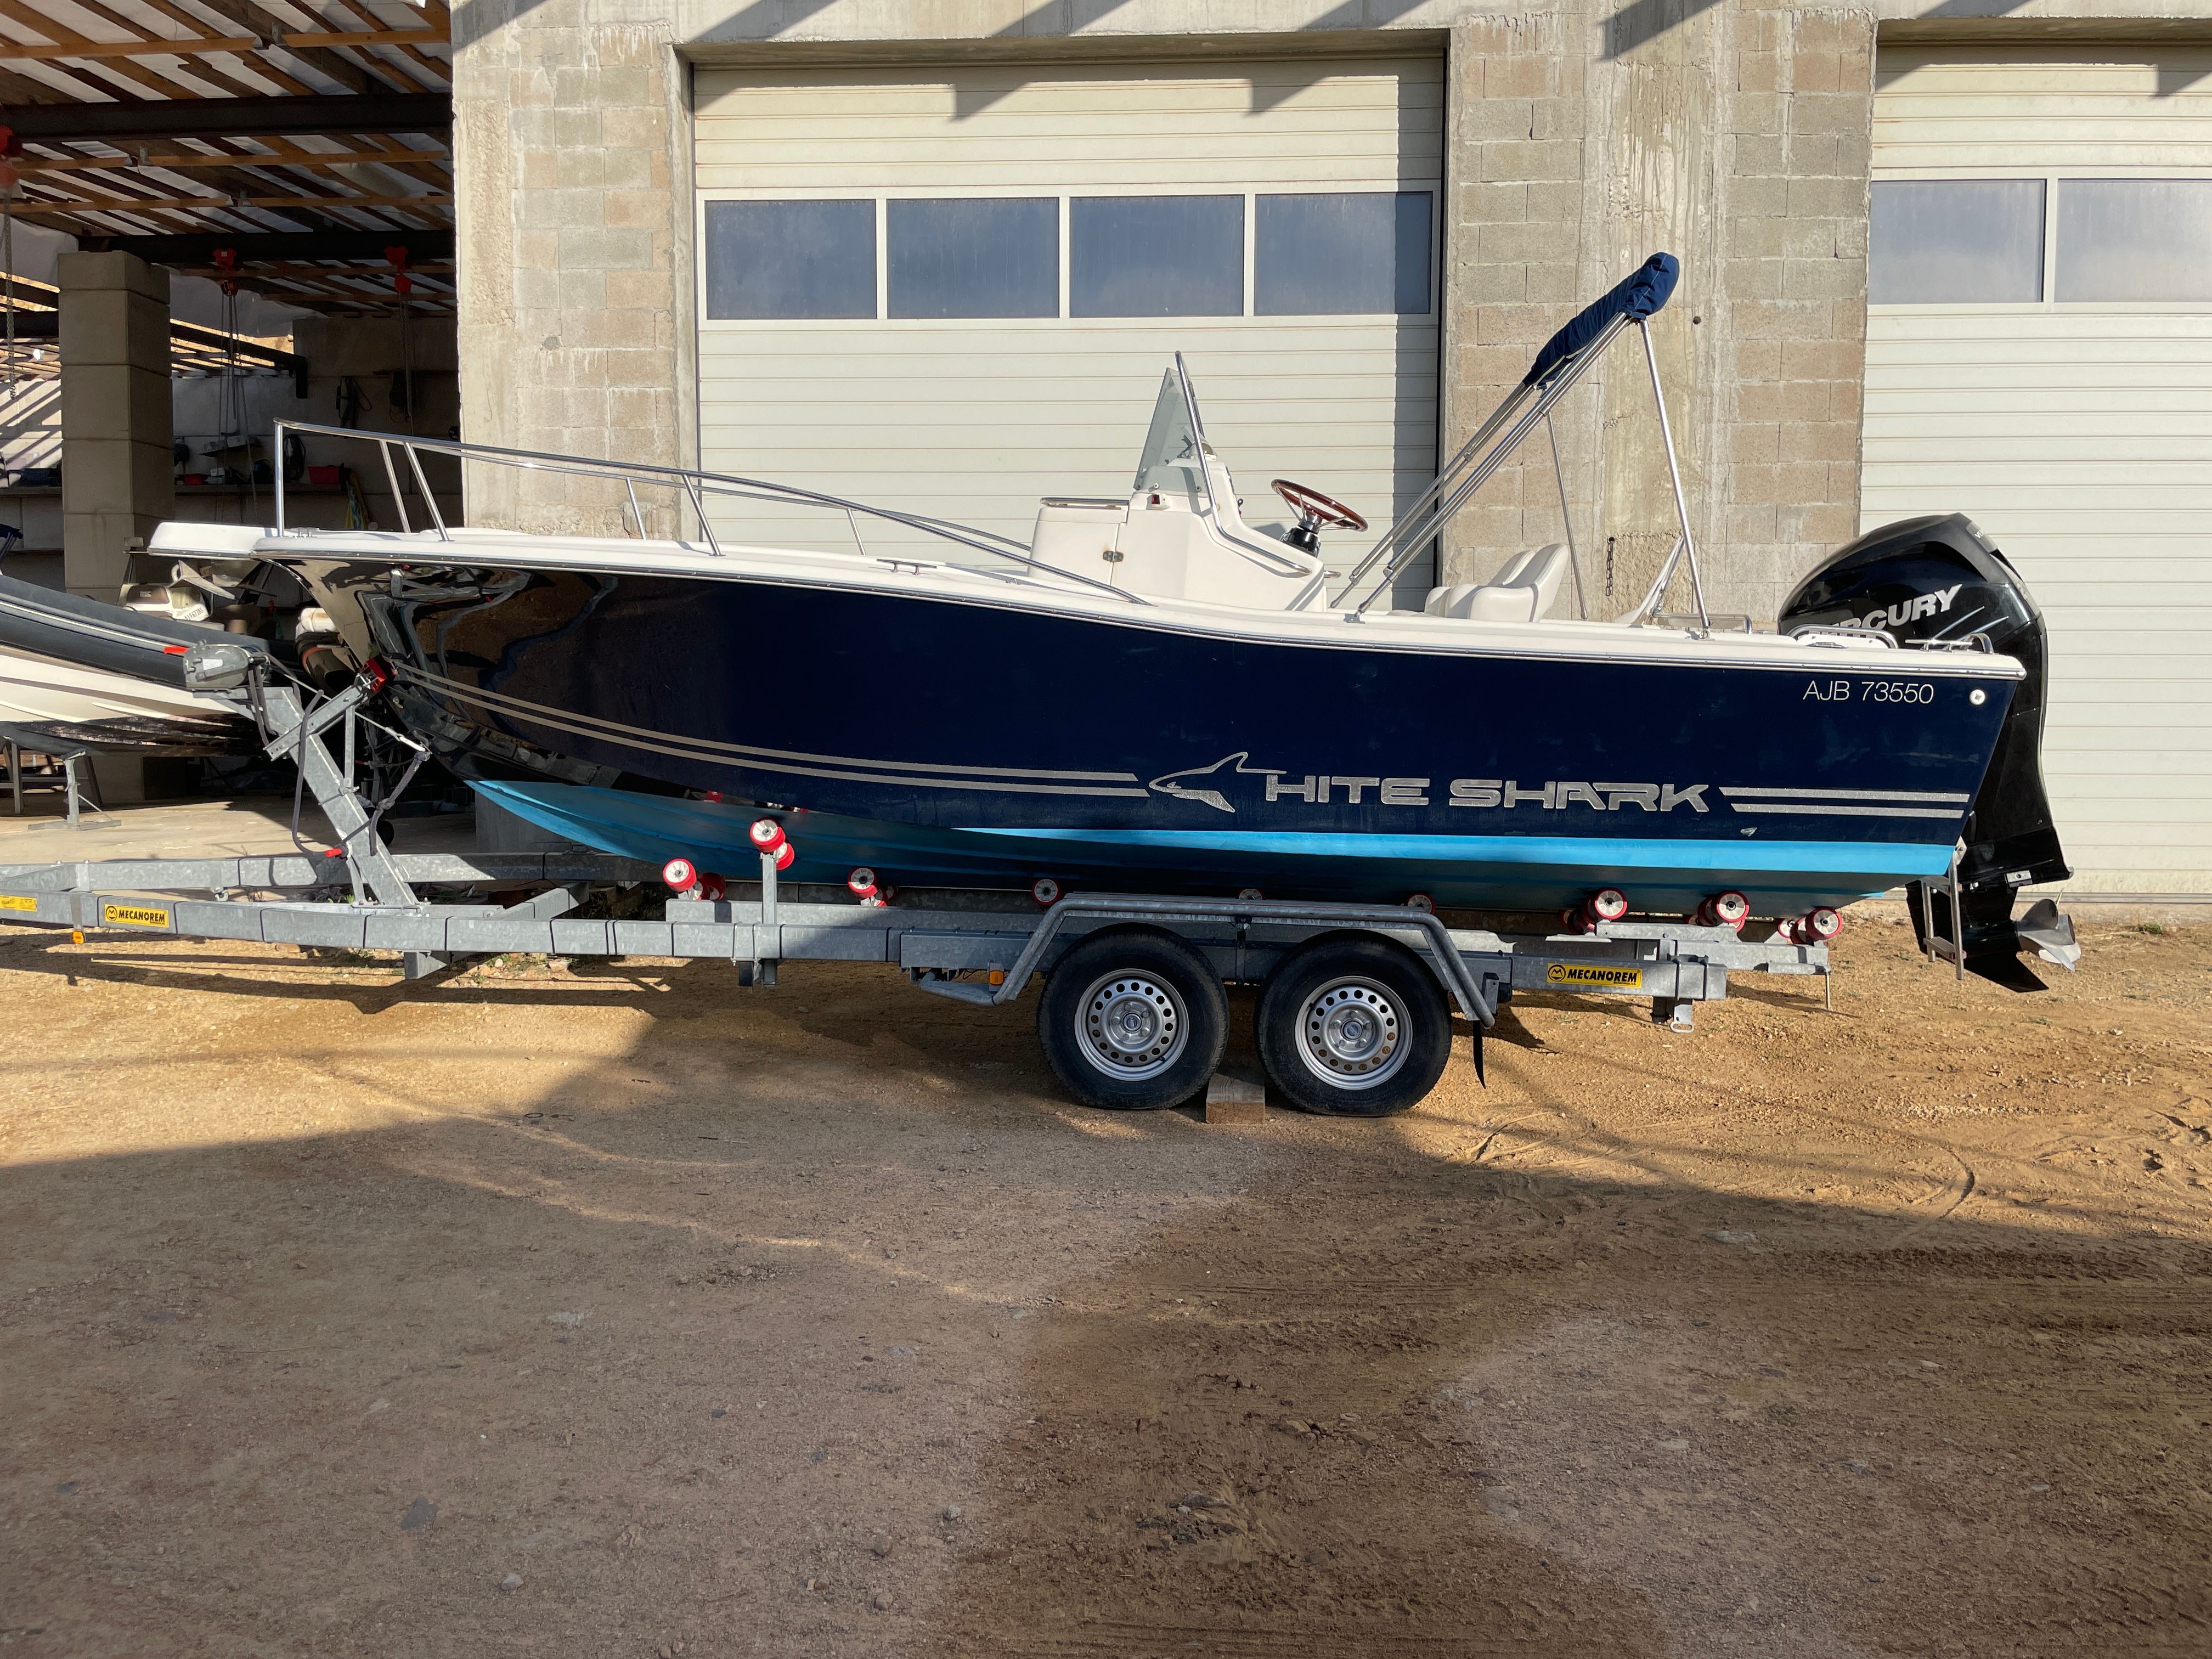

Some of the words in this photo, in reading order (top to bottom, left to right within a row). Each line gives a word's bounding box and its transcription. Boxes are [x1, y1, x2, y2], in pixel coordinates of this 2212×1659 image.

[1803, 680, 1849, 701] AJB
[1861, 681, 1934, 704] 73550
[1266, 775, 1430, 805] HITE
[1449, 778, 1709, 812] SHARK
[119, 910, 165, 922] MECANOREM
[1567, 968, 1637, 983] MECANOREM
